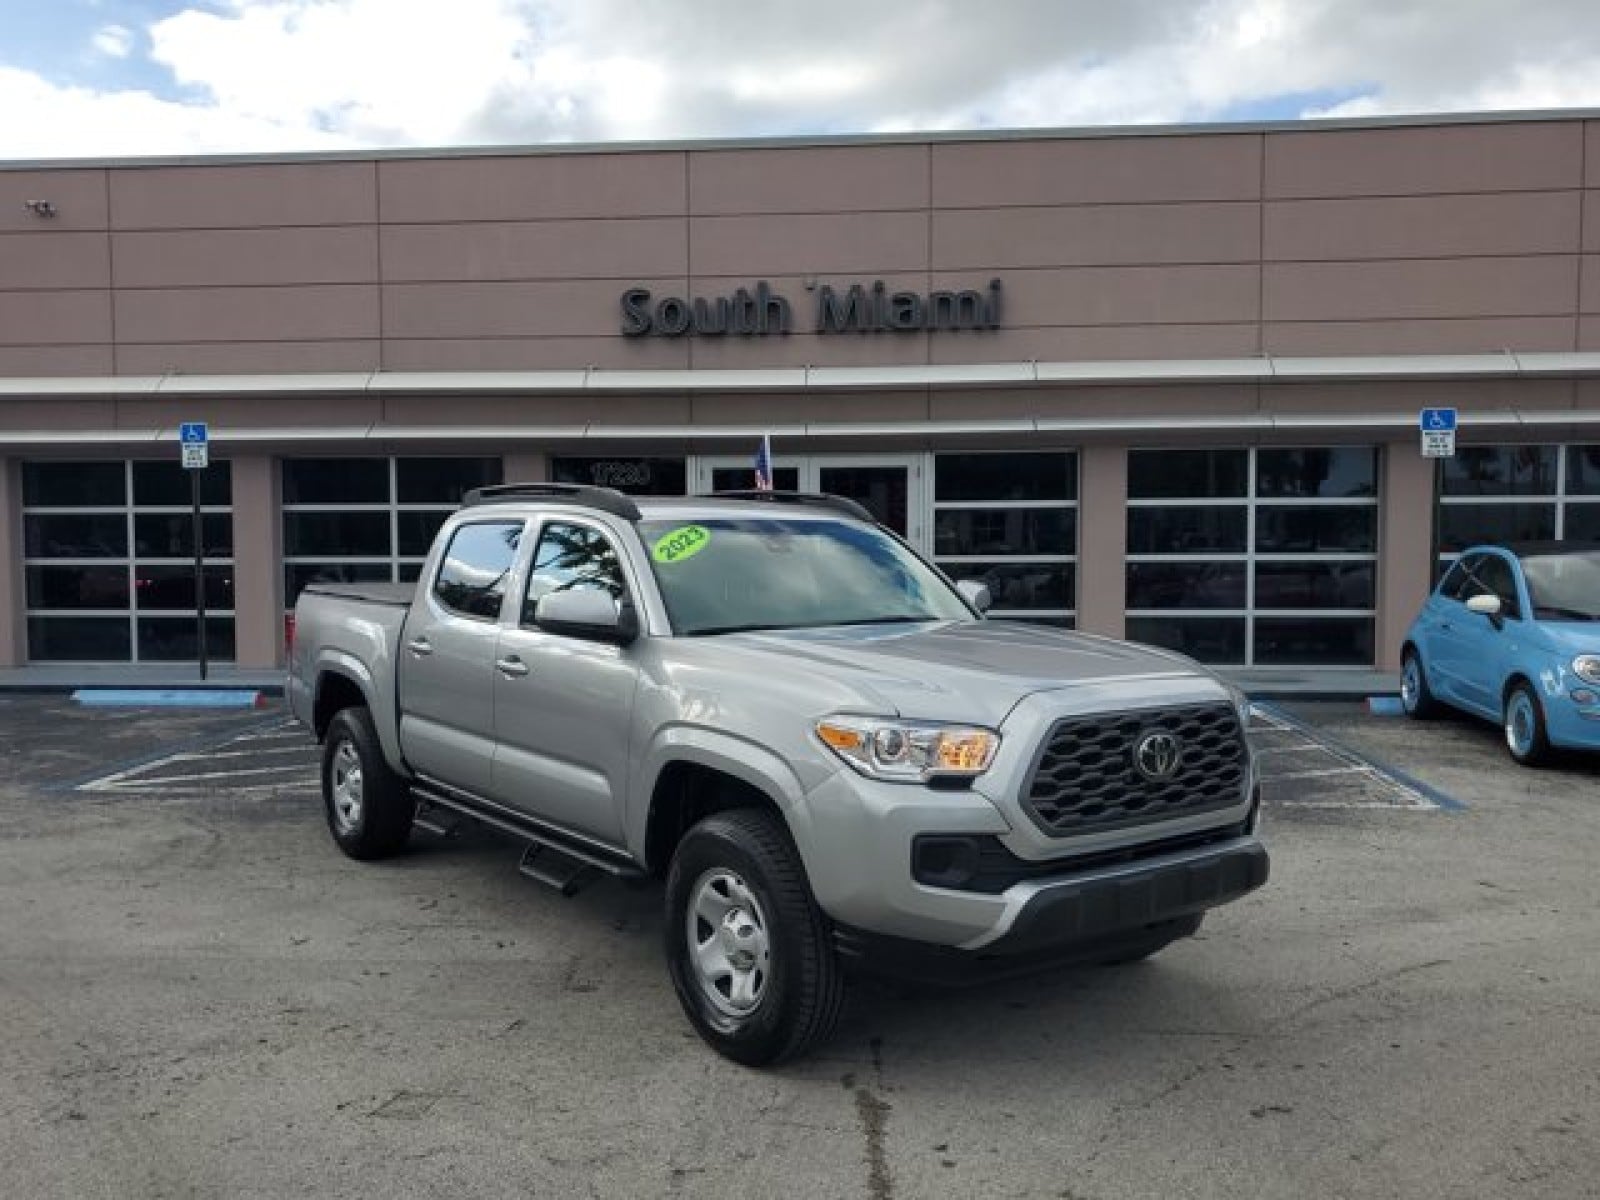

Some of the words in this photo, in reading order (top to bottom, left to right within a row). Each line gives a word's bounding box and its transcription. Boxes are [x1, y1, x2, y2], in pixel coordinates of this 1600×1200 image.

[621, 280, 791, 336] South
[817, 278, 1002, 333] Miami
[659, 526, 704, 561] 2023
